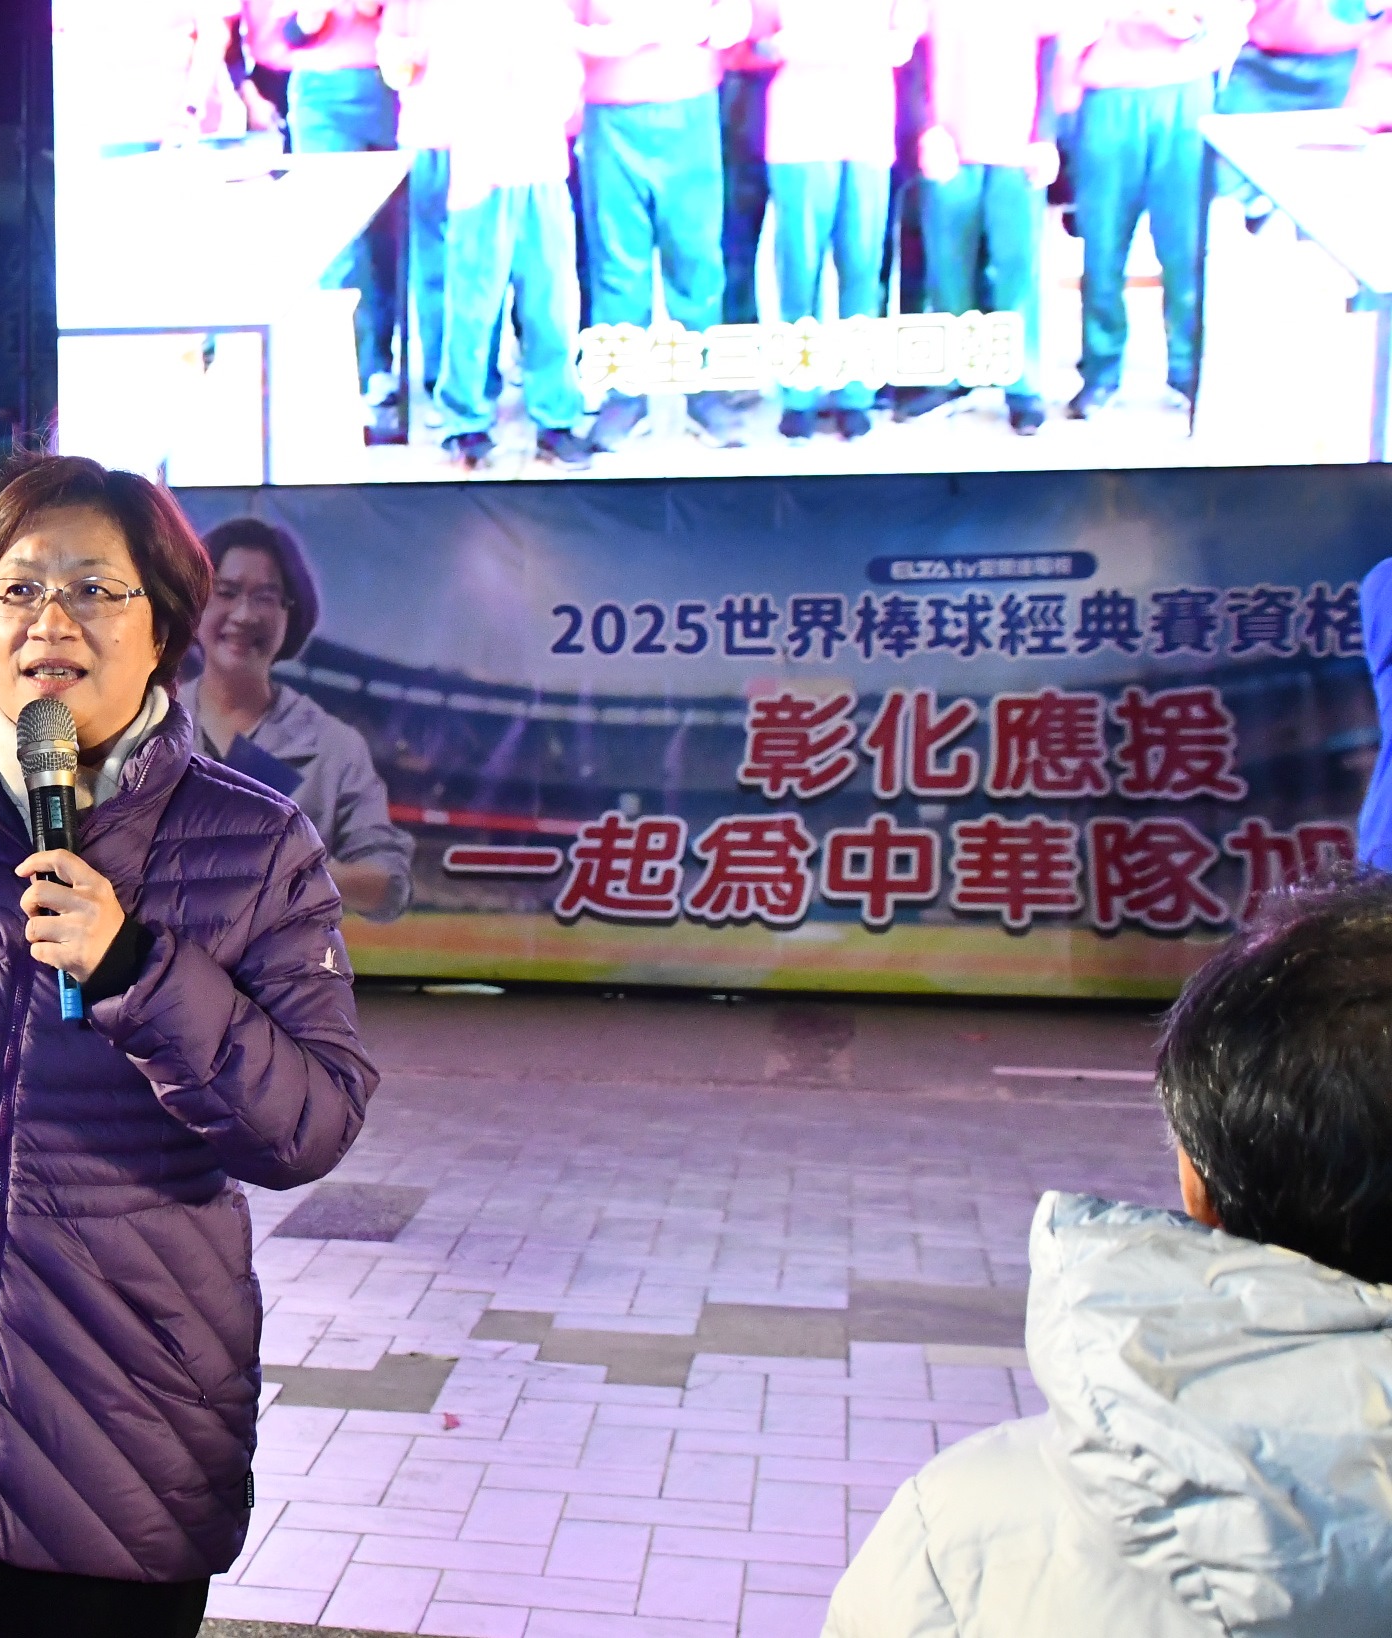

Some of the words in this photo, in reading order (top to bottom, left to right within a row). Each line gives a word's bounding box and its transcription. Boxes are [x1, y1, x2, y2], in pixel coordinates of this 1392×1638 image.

[551, 585, 1364, 658] 2025世界棒球經典賽資格
[739, 688, 1247, 799] 彰化應援
